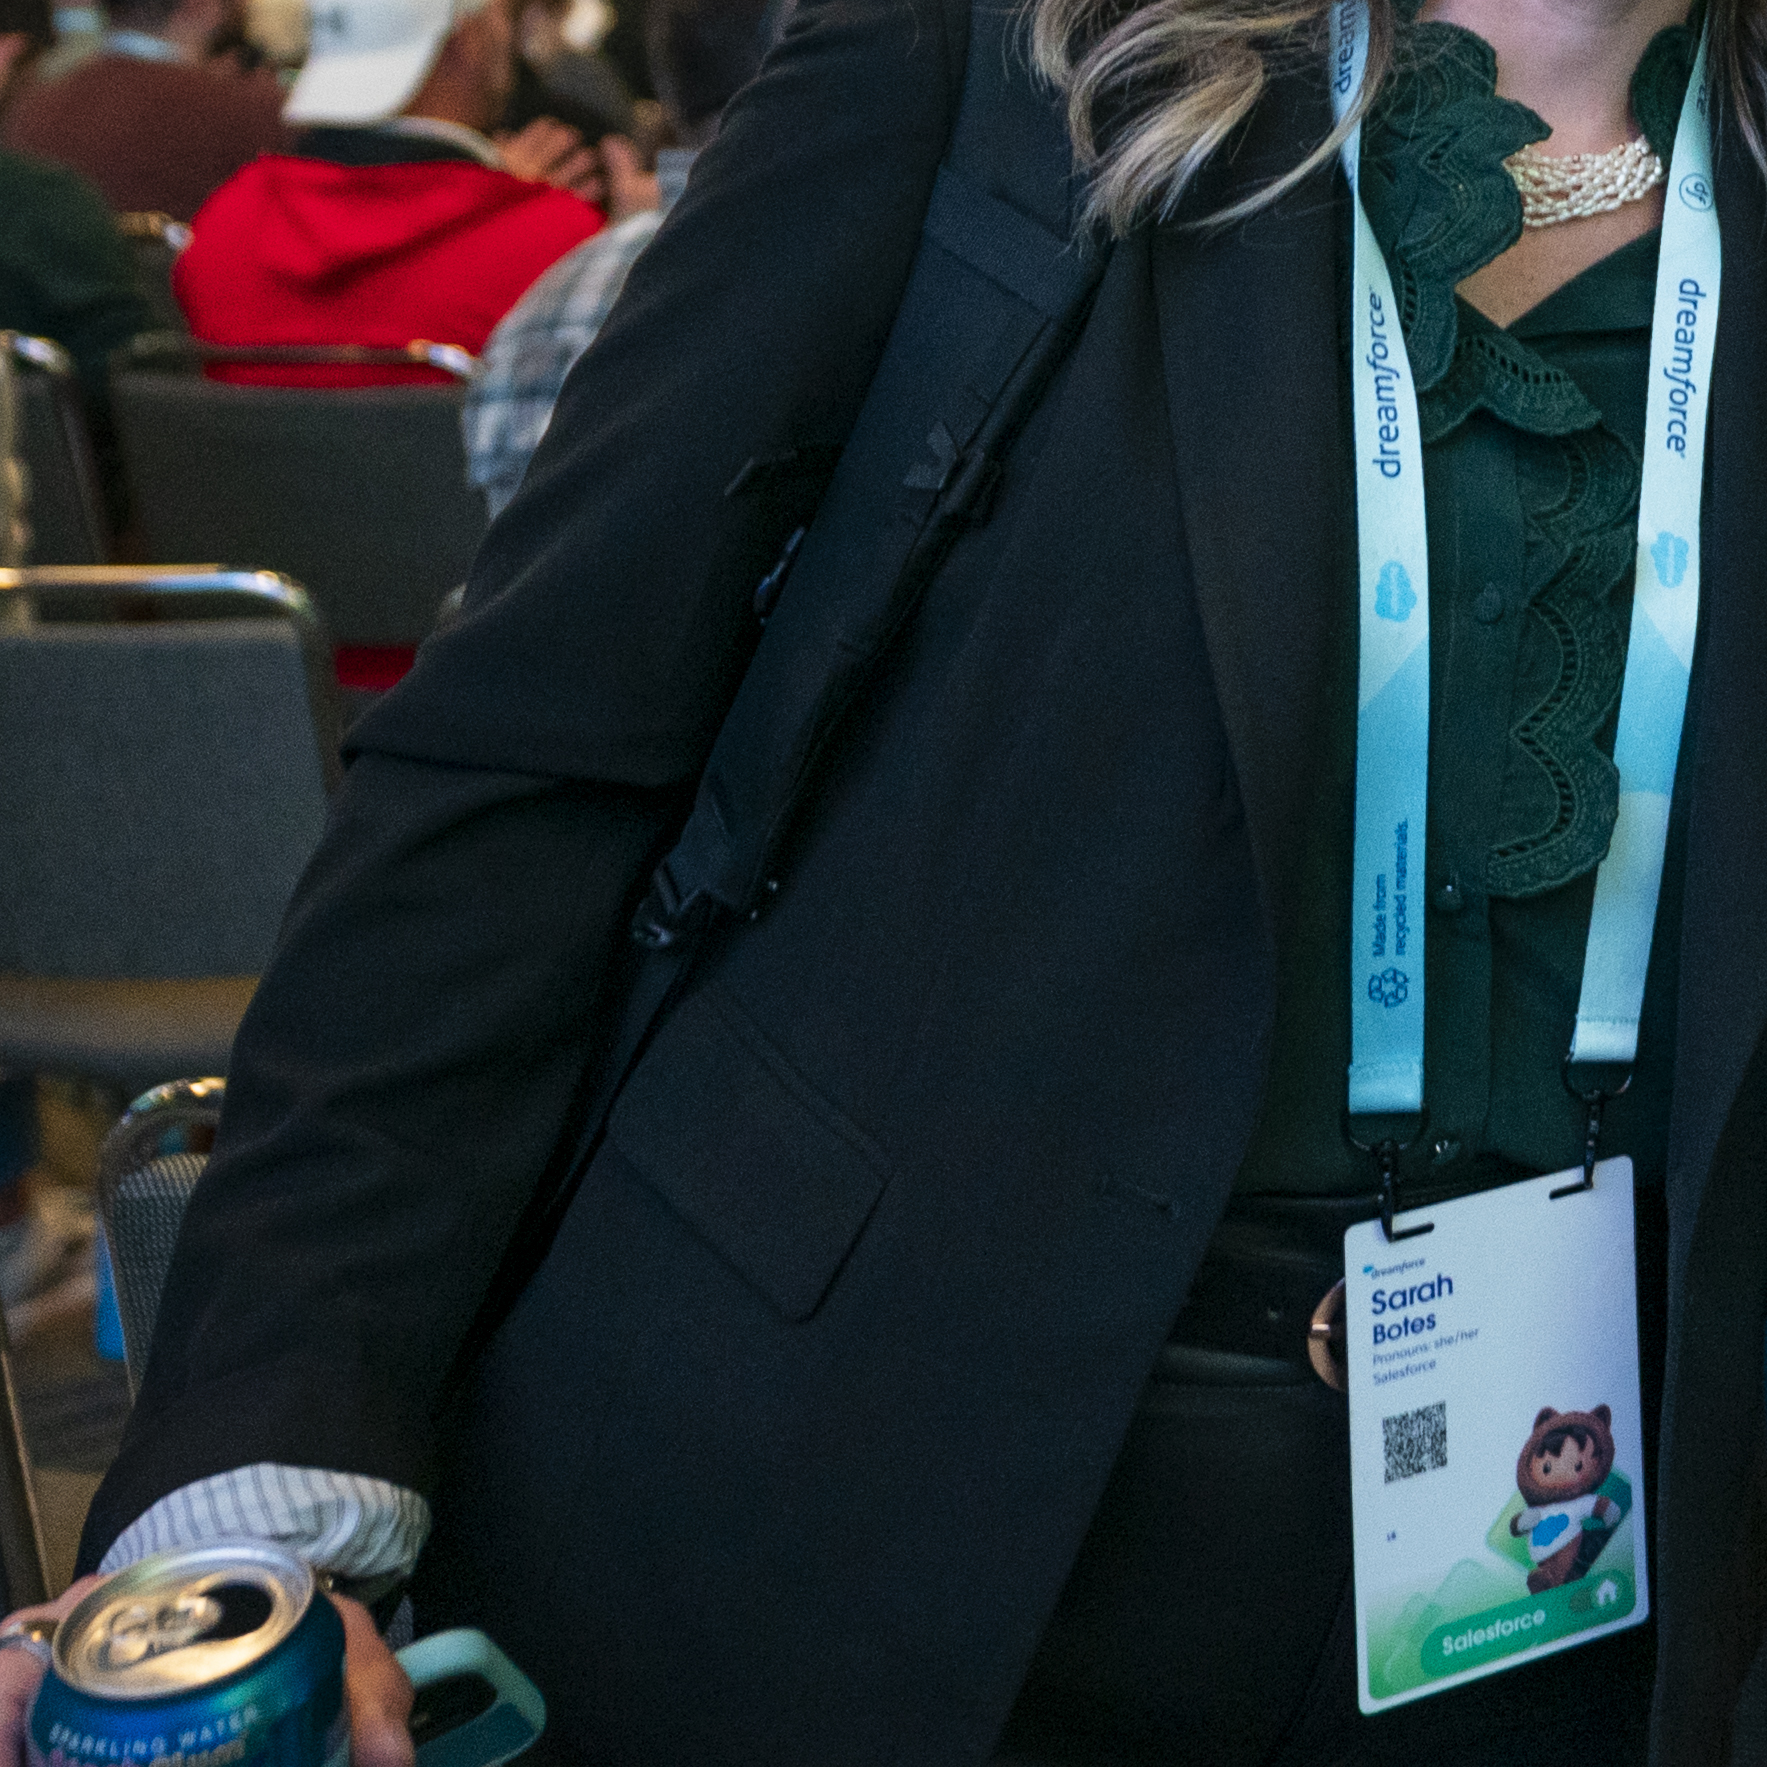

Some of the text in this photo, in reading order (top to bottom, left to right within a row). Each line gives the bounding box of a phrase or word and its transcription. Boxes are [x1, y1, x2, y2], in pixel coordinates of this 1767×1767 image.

[1366, 291, 1401, 478] dreamforce
[1663, 278, 1707, 453] dreamforce
[1372, 873, 1387, 958] Made from
[1393, 894, 1410, 956] recycled
[1371, 1273, 1453, 1315] Sarah
[1373, 1313, 1437, 1345] Botes
[1434, 1328, 1479, 1349] she/her
[1373, 1359, 1437, 1386] Salesforce
[1442, 1609, 1546, 1657] Salesforce
